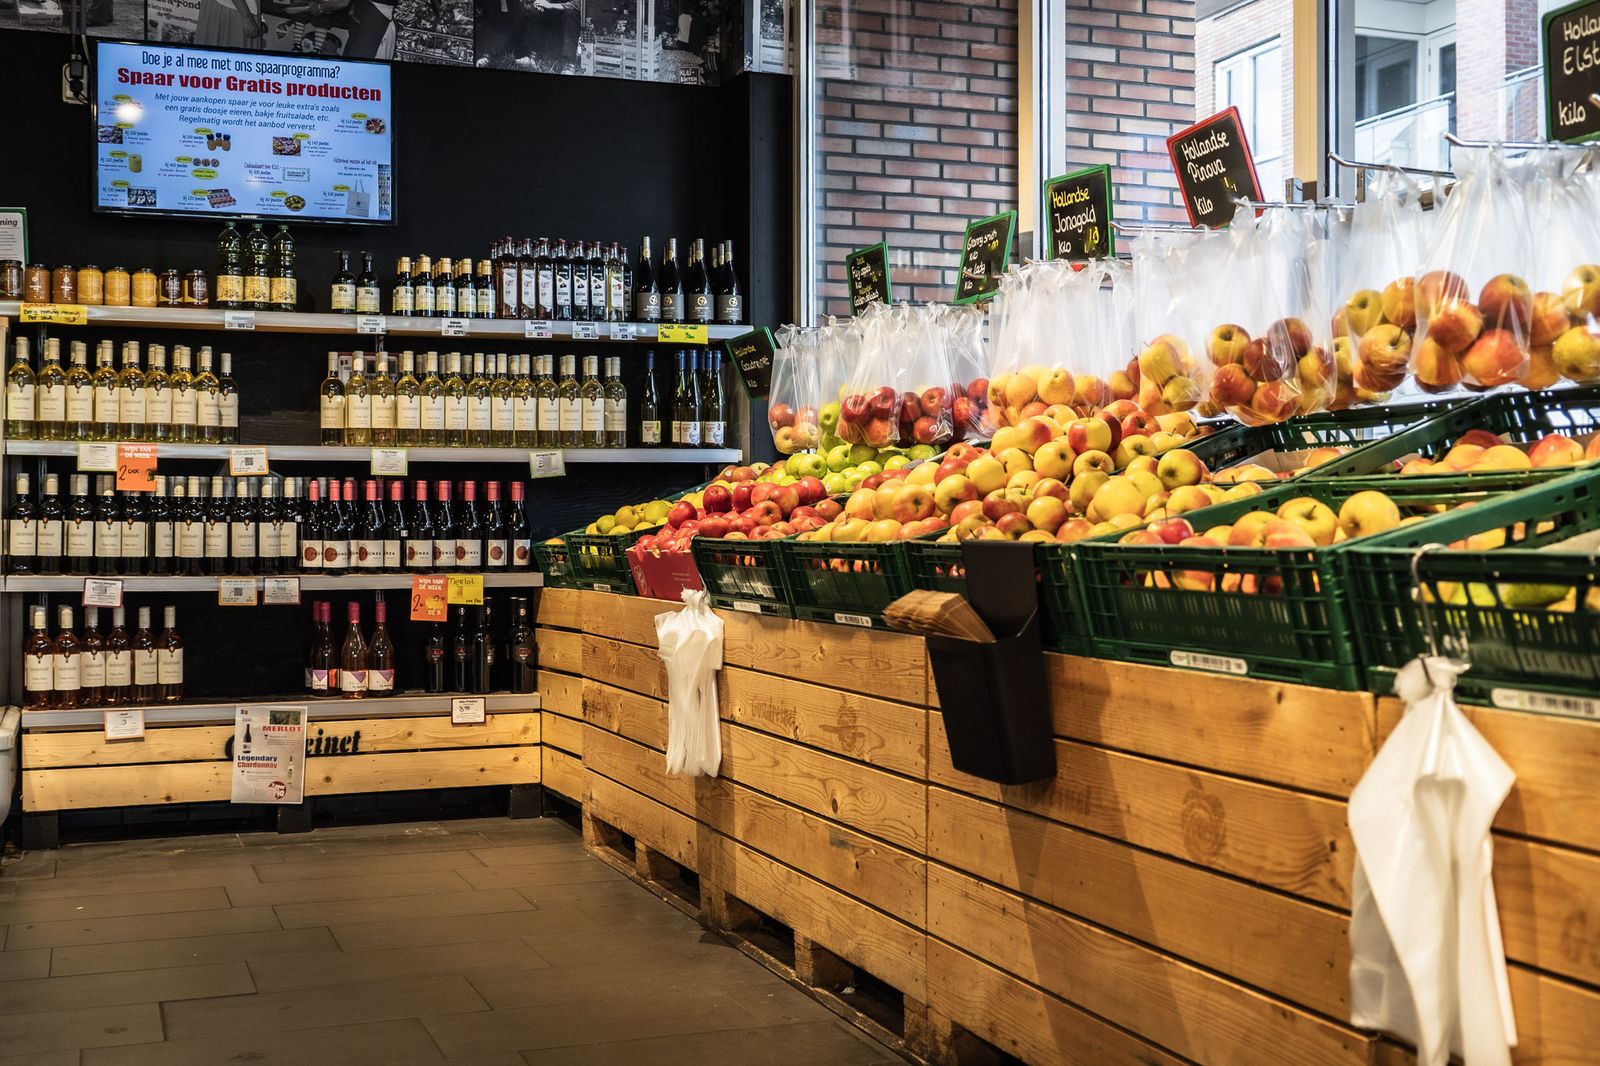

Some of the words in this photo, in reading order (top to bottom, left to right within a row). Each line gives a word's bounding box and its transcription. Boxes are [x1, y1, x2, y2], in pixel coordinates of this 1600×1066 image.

[142, 51, 160, 65] Doe
[162, 53, 172, 69] je
[176, 54, 184, 67] al
[187, 58, 208, 69] mee
[211, 58, 231, 71] met
[235, 62, 252, 73] ons
[255, 62, 341, 79] spaarprogramma?
[117, 67, 175, 86] Spaar
[178, 74, 222, 90] voor
[226, 75, 282, 94] Gratis
[286, 82, 382, 101] producten
[154, 93, 169, 101] Met
[170, 94, 189, 104] jouw
[190, 96, 227, 106] aankopen
[227, 99, 249, 108] spaar
[249, 99, 257, 108] je
[258, 101, 274, 109] voor
[276, 101, 295, 110] leuke
[296, 102, 320, 112] extra's
[321, 104, 340, 113] zoals
[180, 104, 202, 114] gratis
[203, 106, 228, 116] doosje
[229, 108, 253, 118] eieren,
[254, 109, 274, 120] bakje
[276, 111, 315, 122] fruitsalade,
[317, 114, 330, 122] etc.
[178, 114, 220, 126] Regelmatig
[222, 117, 243, 127] wordt
[245, 118, 257, 127] het
[258, 120, 285, 129] aanbod
[286, 123, 317, 131] ververst.
[1181, 129, 1230, 161] Hollandse
[1187, 158, 1226, 183] Pinova
[1052, 186, 1090, 209] Hollandse
[1054, 204, 1097, 233] Jonagold
[237, 761, 278, 769] Chardonnay
